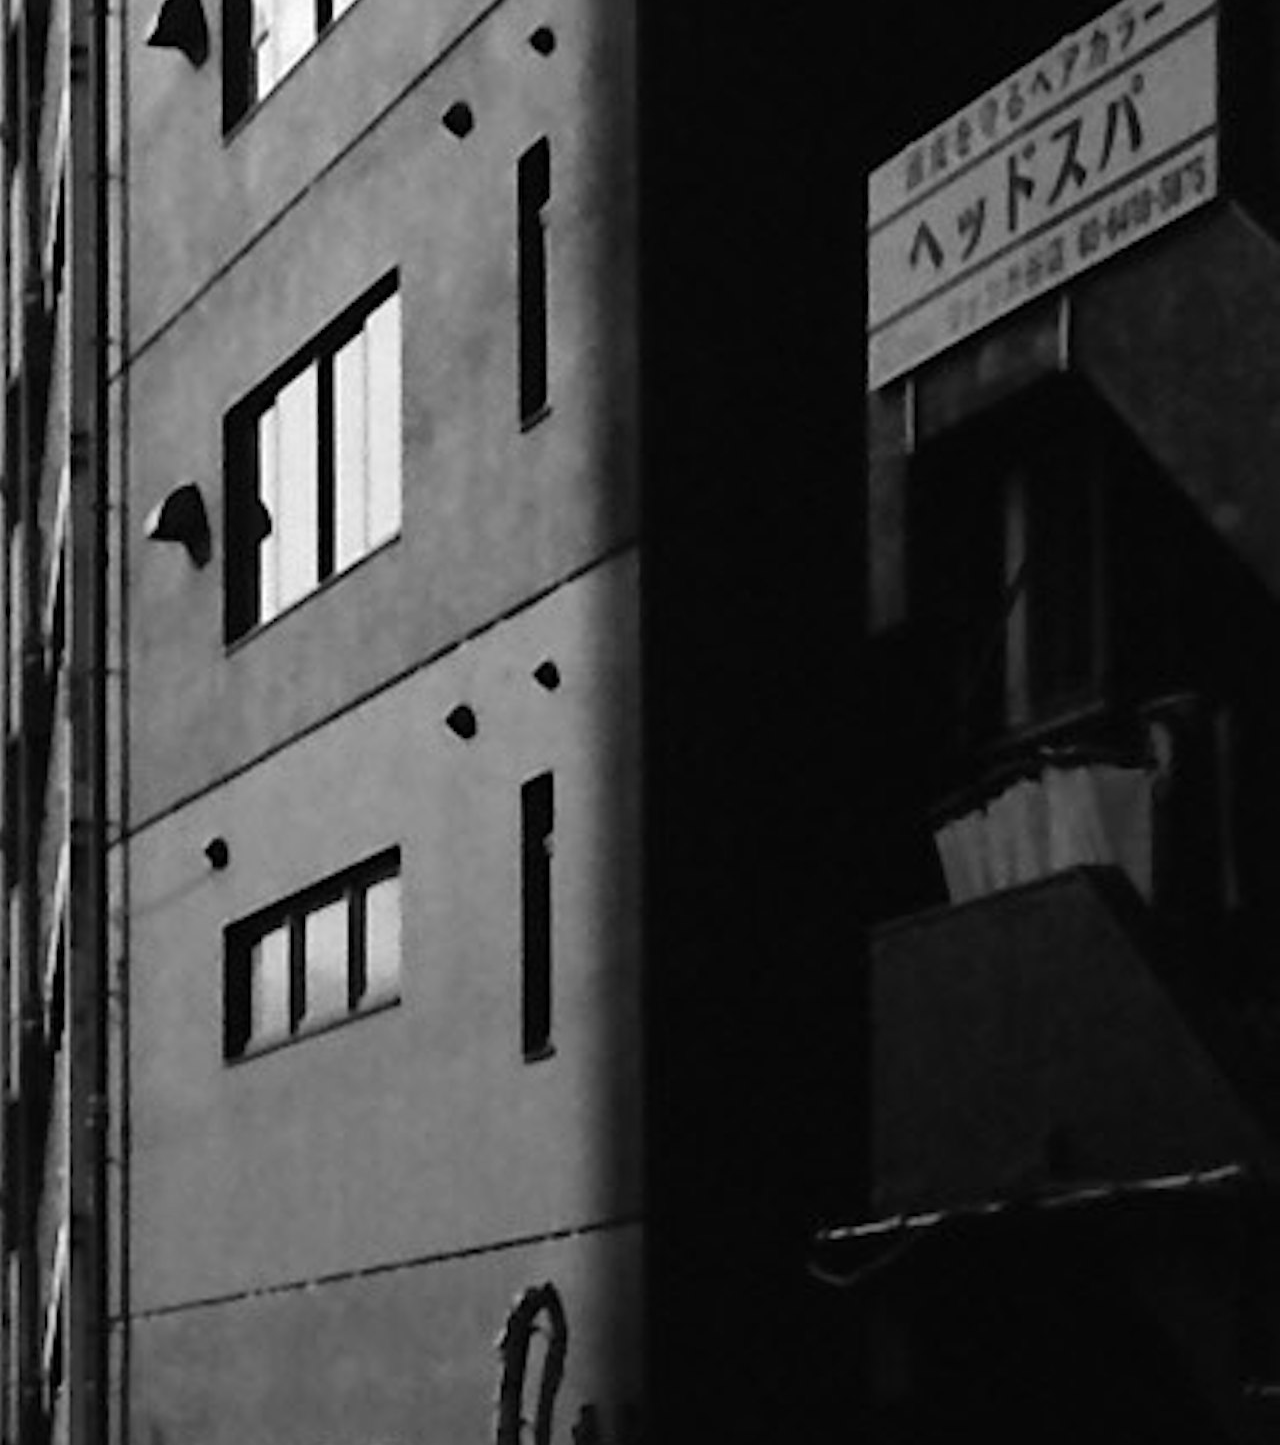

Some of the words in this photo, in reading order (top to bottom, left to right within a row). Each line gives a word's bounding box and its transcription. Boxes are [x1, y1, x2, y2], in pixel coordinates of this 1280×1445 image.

[909, 72, 1146, 271] ヘッドスパ
